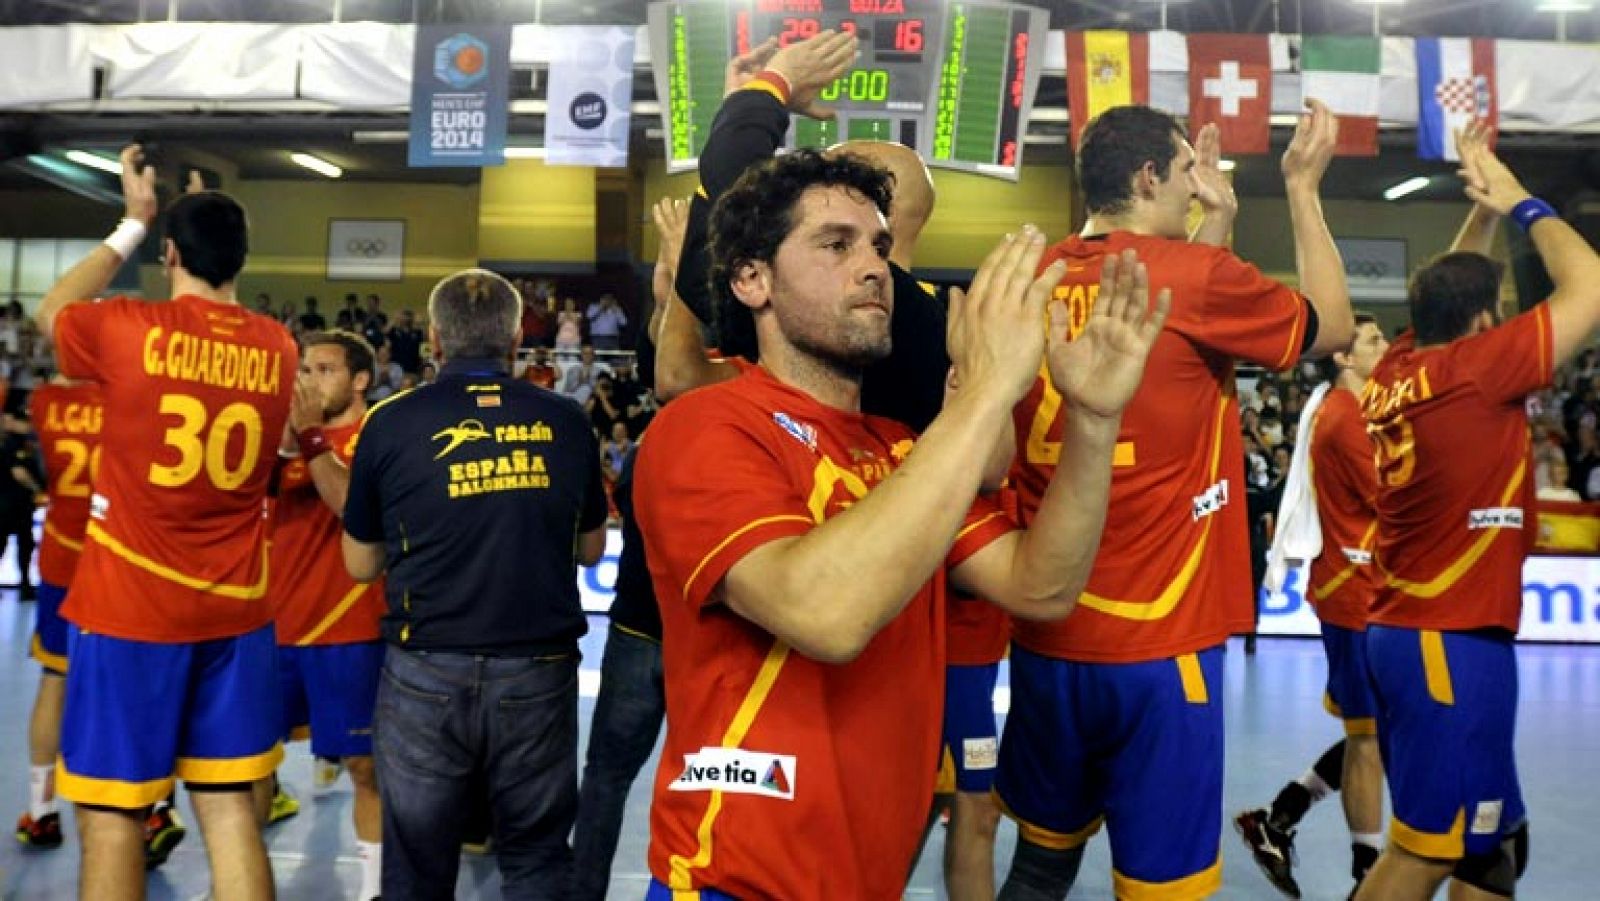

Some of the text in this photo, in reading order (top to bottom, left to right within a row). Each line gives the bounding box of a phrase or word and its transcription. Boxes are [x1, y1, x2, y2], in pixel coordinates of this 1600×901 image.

[896, 20, 924, 52] 16
[431, 110, 486, 128] EURO
[431, 129, 484, 148] 2014
[143, 326, 281, 396] G.GUARDIOLA
[149, 393, 263, 491] 30
[495, 420, 553, 442] rasán
[449, 449, 547, 481] ESPAÑA
[447, 474, 550, 498] BALONMANO
